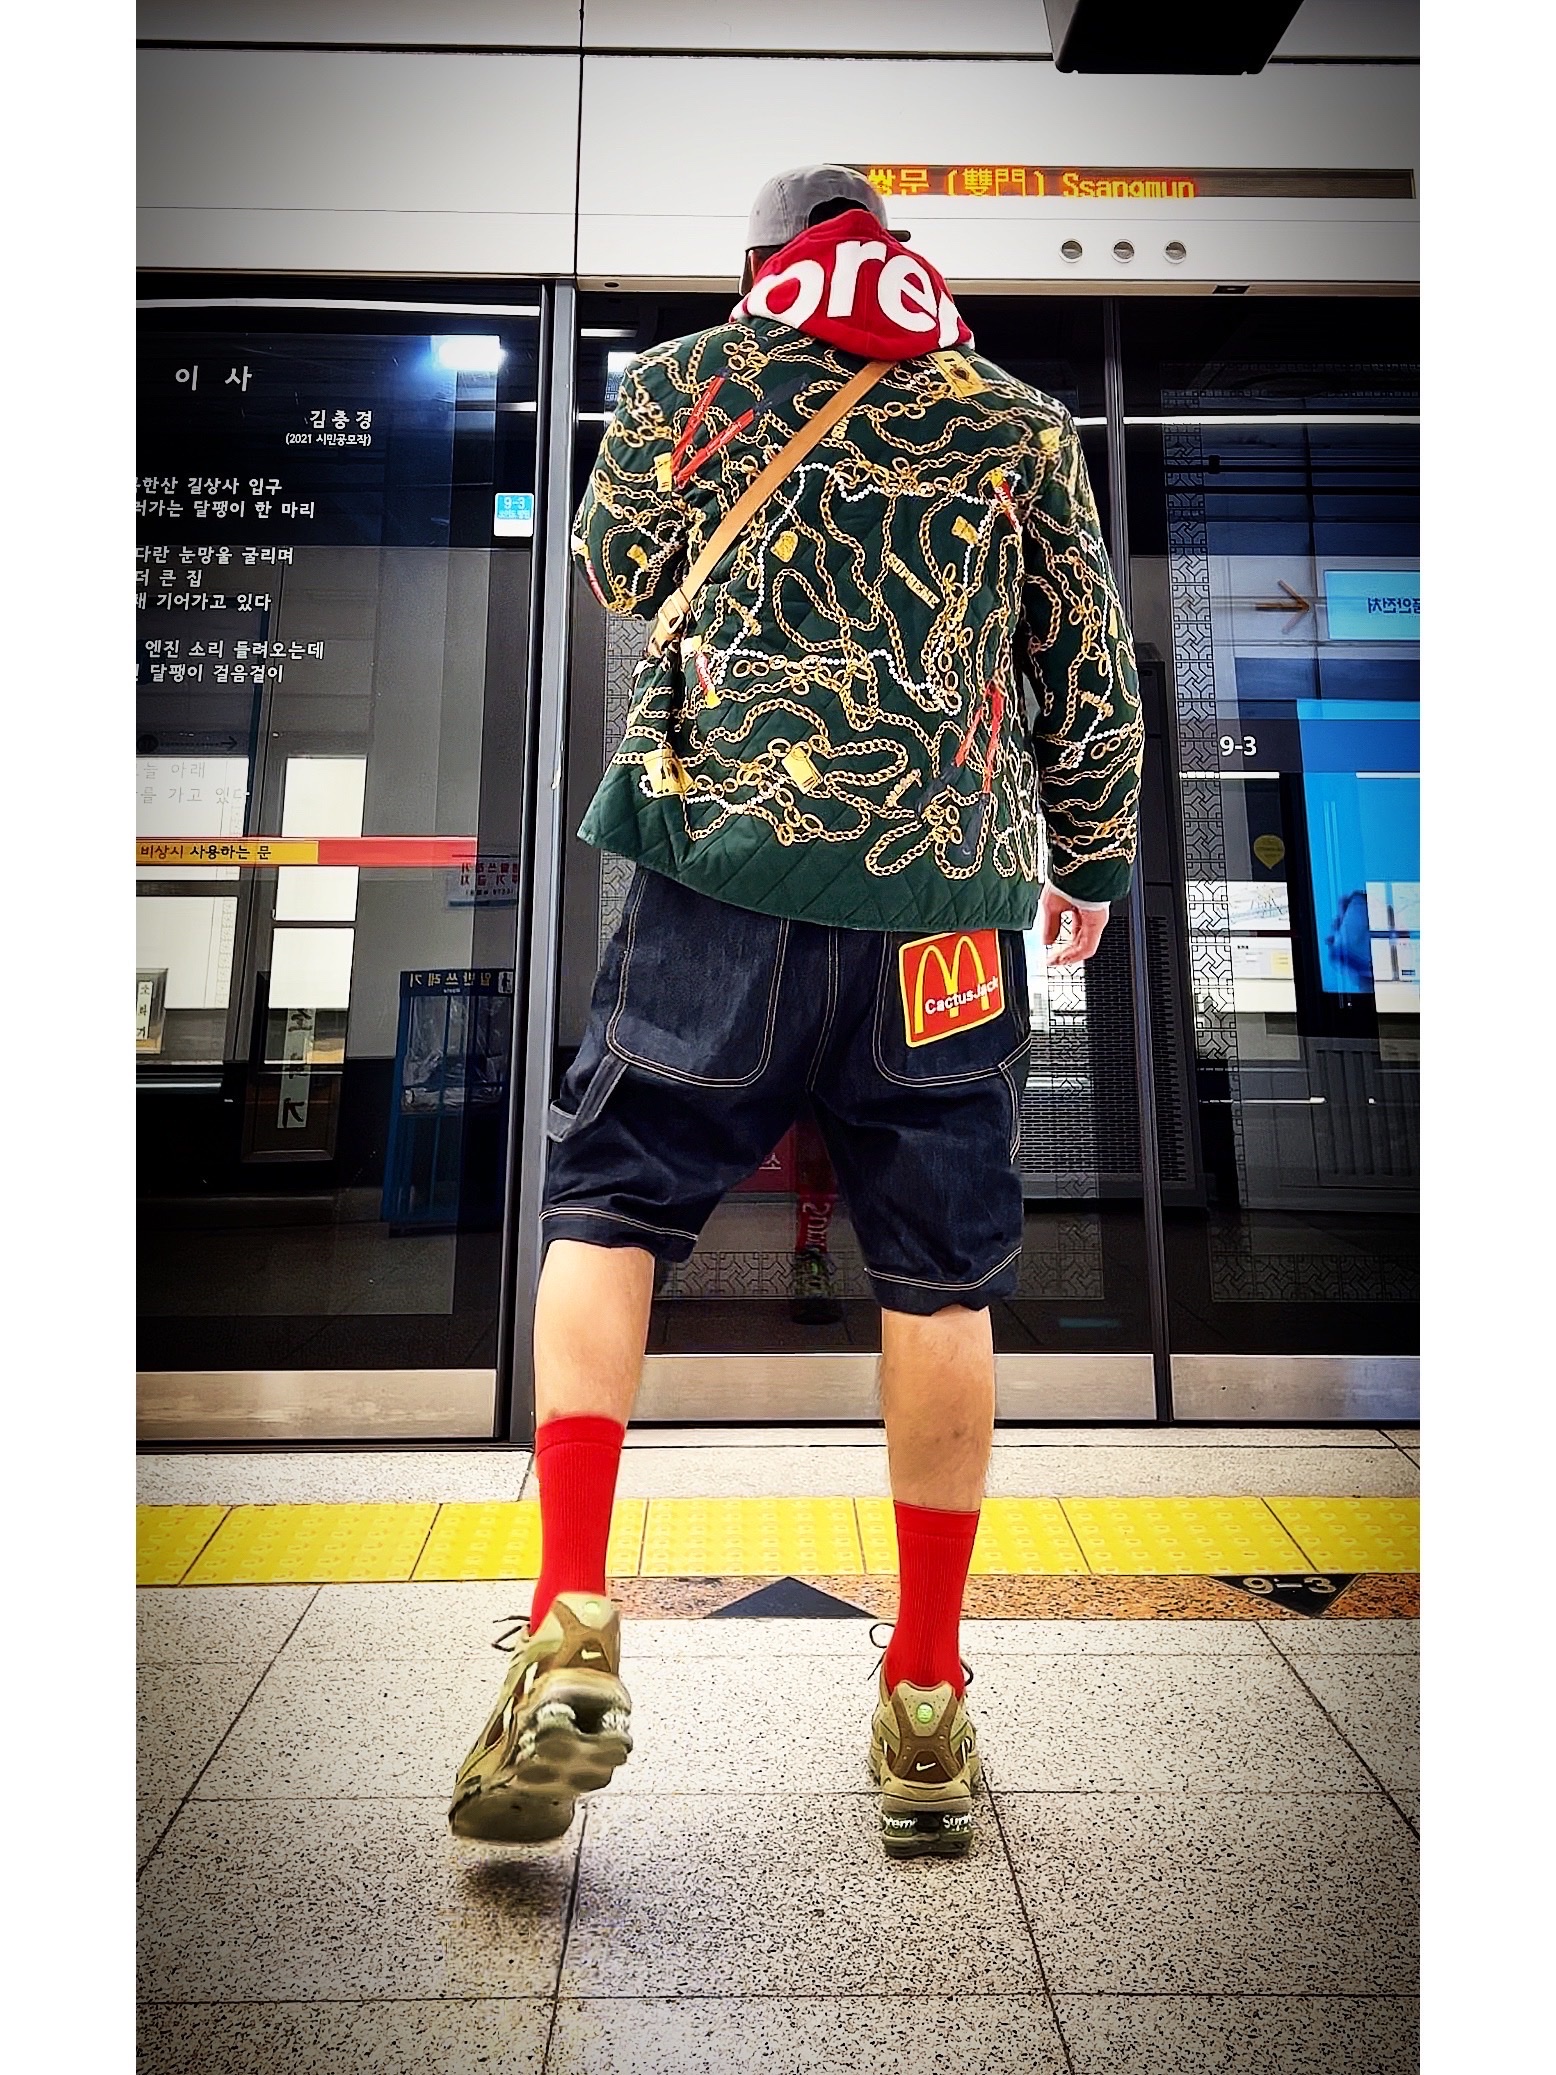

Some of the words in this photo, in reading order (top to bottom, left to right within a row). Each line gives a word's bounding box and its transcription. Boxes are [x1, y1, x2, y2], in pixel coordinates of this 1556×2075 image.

[1062, 171, 1195, 198] Ssangmun
[285, 432, 313, 446] (2021
[315, 433, 372, 447] 시민공모작)
[136, 476, 179, 494] 한산
[187, 477, 240, 495] 길상사
[248, 477, 283, 496] 입구
[193, 500, 246, 518] 달팽이
[254, 500, 273, 519] 한
[281, 501, 315, 519] 마리
[503, 496, 525, 510] 9-3
[178, 546, 233, 565] 눈망울
[241, 547, 294, 565] 굴리며
[159, 569, 177, 587] 큰
[186, 569, 203, 588] 집
[156, 592, 227, 611] 기어가고
[236, 593, 272, 612] 있다
[144, 639, 180, 659] 엔진
[188, 639, 224, 659] 소리
[233, 640, 326, 660] 들려오는데
[150, 663, 203, 683] 달팽이
[212, 664, 285, 684] 걸음걸이
[1219, 735, 1258, 757] 9-3
[170, 761, 206, 779] 아래
[168, 786, 203, 804] 가고
[140, 844, 184, 860] 비상시
[189, 844, 251, 860] 사용하는
[256, 845, 272, 860] 문
[1242, 1576, 1337, 1594] 9-3
